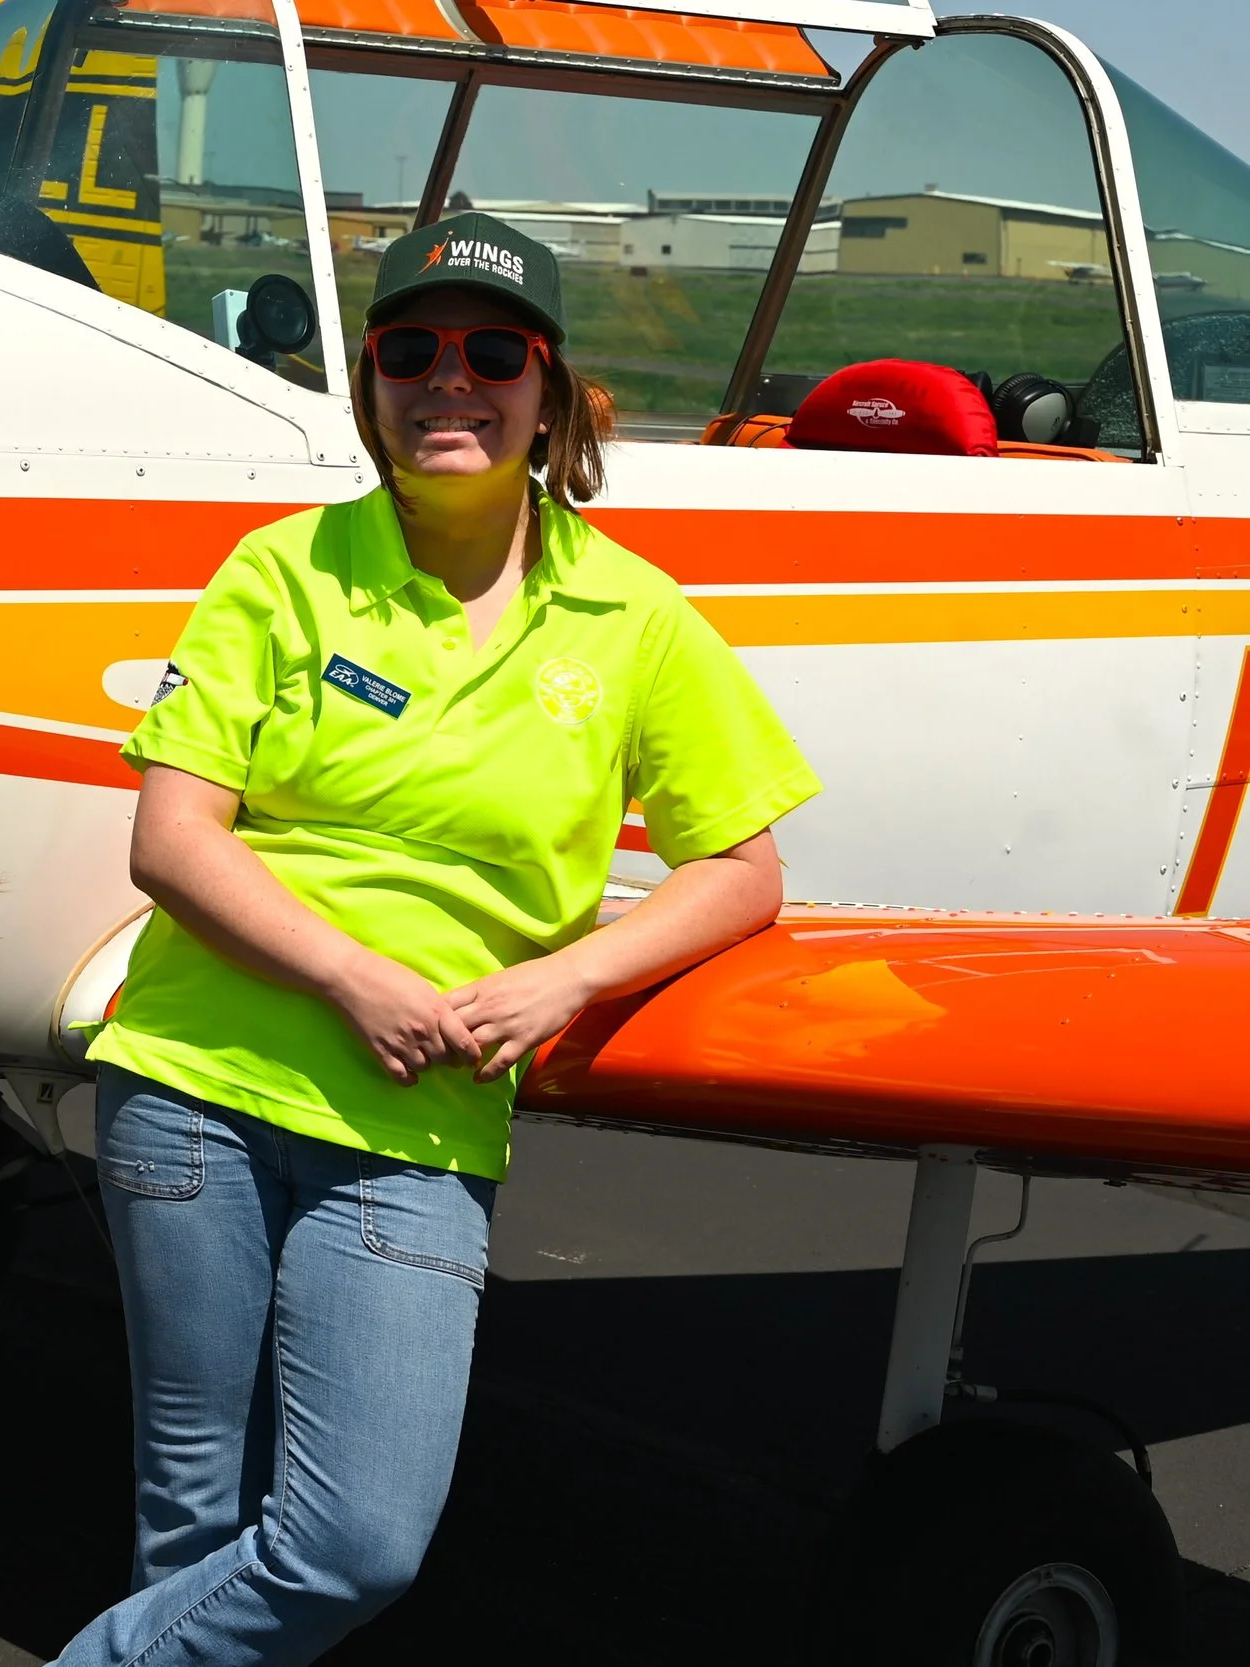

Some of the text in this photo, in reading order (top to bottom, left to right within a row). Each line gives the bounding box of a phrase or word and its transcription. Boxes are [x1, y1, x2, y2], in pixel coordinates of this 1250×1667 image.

[451, 240, 524, 274] WINGS
[448, 257, 524, 285] OVER THE ROCKIES
[329, 670, 353, 685] EAA
[362, 675, 407, 703] VALERIE BLOME
[365, 685, 389, 700] CHAPTER
[368, 693, 389, 706] DENVER
